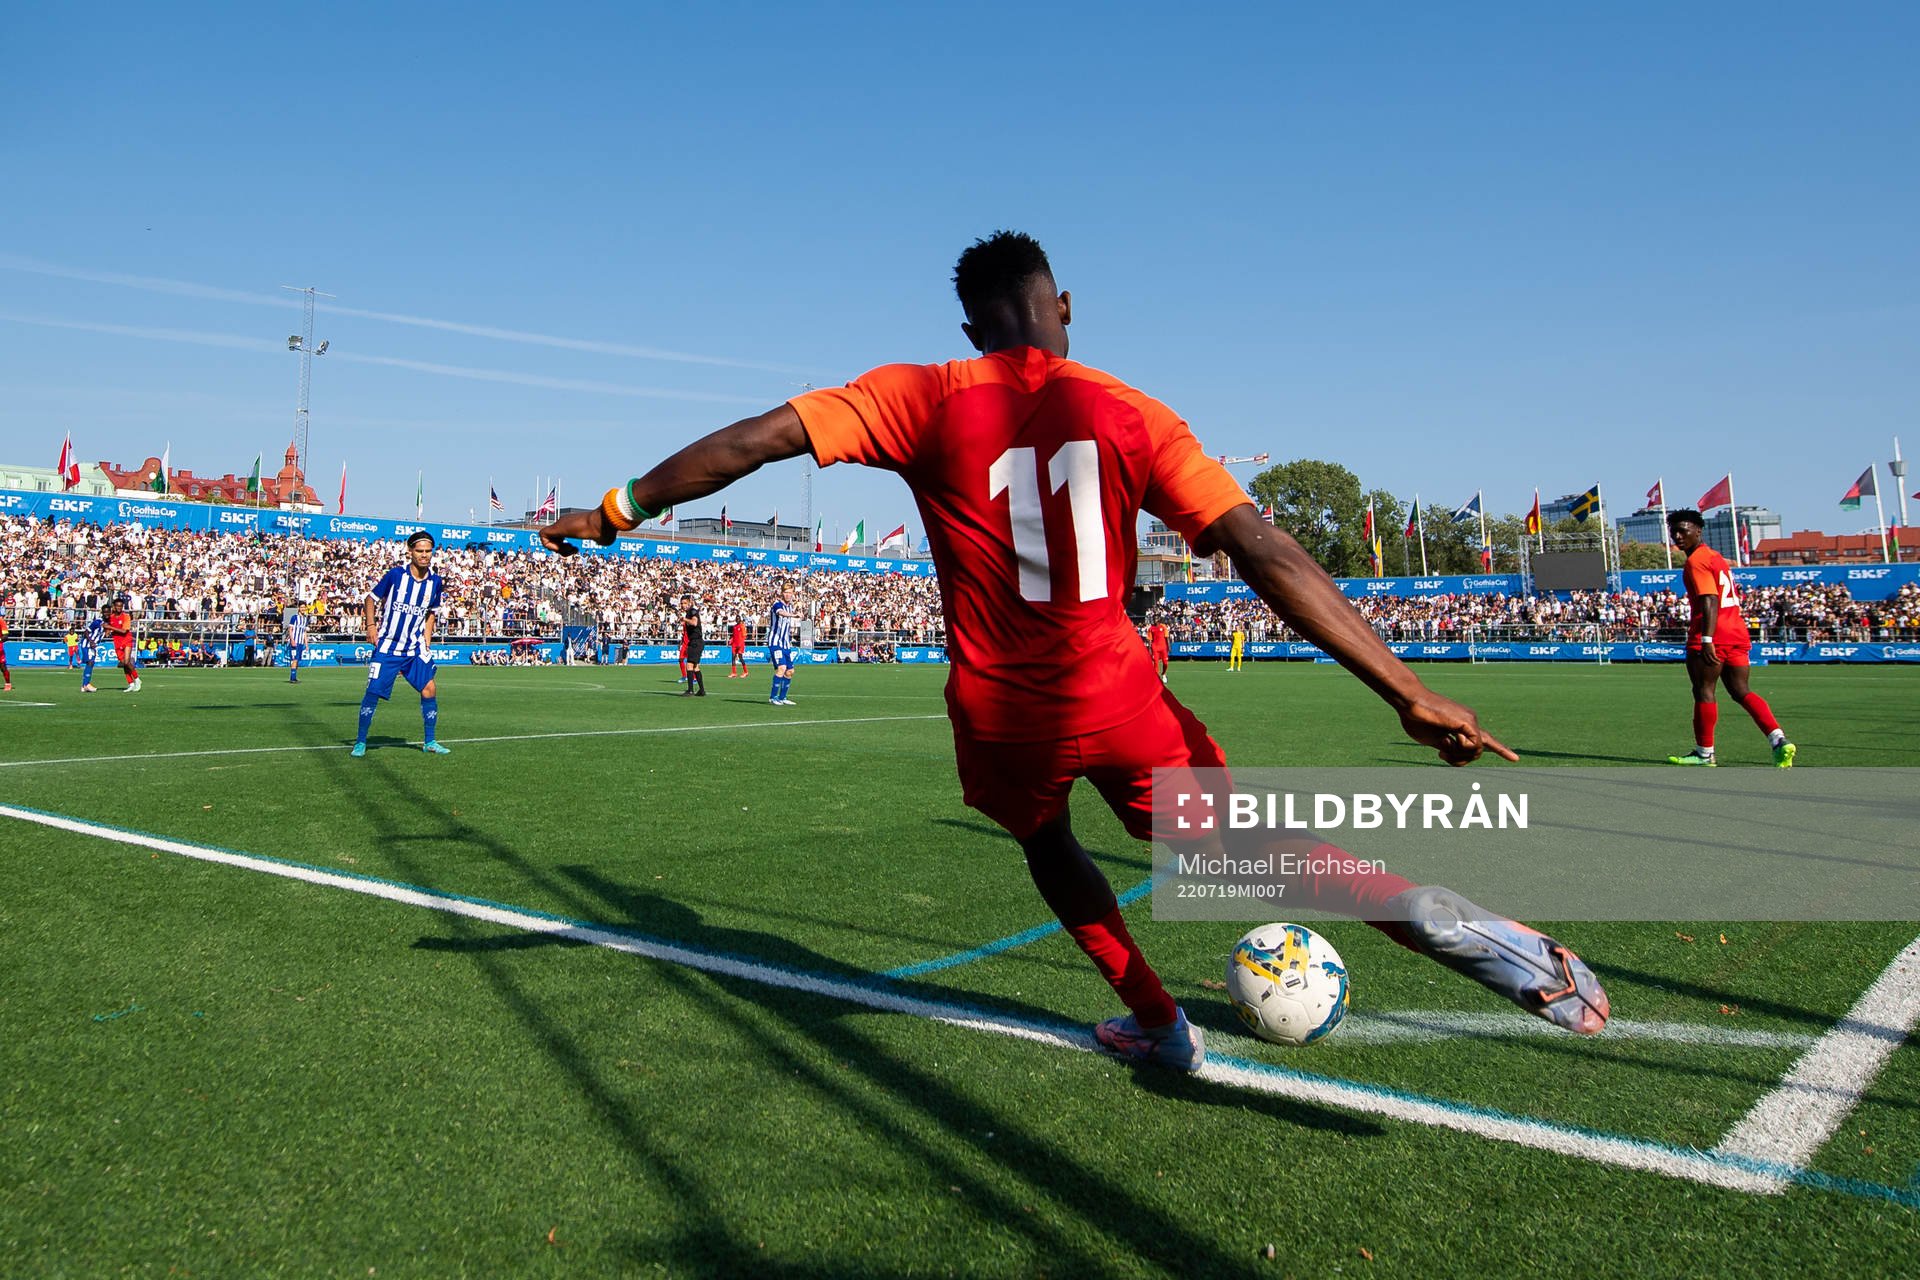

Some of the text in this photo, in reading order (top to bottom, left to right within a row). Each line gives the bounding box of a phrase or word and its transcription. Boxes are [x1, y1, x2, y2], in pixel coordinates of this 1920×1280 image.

[50, 499, 93, 512] SKF
[132, 506, 177, 518] Gothia Cup
[220, 512, 257, 524] SKF
[277, 516, 311, 528] SKF
[989, 440, 1108, 602] 11
[364, 524, 378, 533] Cup
[442, 529, 471, 539] SKF
[487, 532, 515, 542] SKF
[620, 542, 644, 551] SKF
[656, 545, 680, 554] SKF
[712, 549, 733, 558] SKF
[746, 552, 766, 560] SKF
[779, 554, 798, 562] SKF
[848, 559, 866, 568] SKF
[876, 561, 892, 569] SKF
[902, 563, 918, 571] SKF
[1782, 571, 1822, 580] SKF
[1848, 569, 1890, 579] SKF
[1641, 575, 1677, 584] SKF
[1367, 582, 1396, 590] SKF
[1414, 581, 1444, 589] SKF
[18, 648, 65, 660] SKF
[1423, 646, 1450, 654] SKF
[1530, 647, 1560, 655] SKF
[1583, 647, 1614, 655] SKF
[1670, 648, 1684, 656] Cup
[1761, 647, 1797, 656] SKF
[1820, 648, 1858, 656] SKF
[812, 653, 828, 661] SKF
